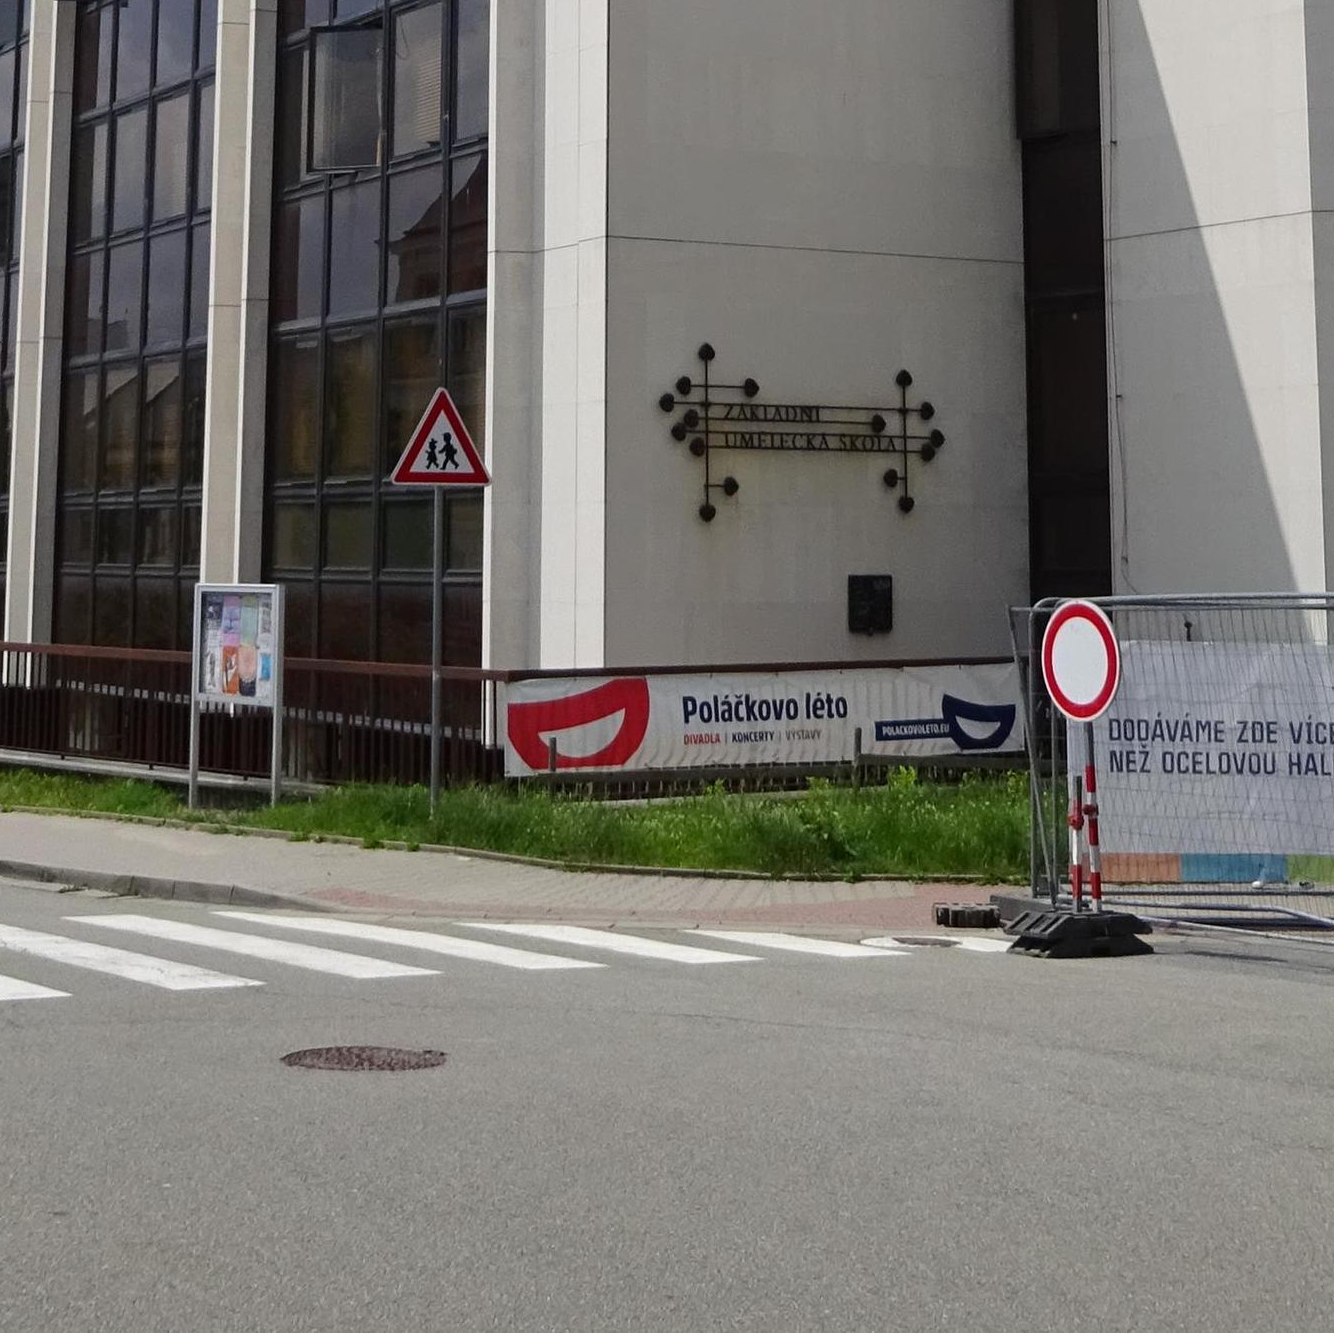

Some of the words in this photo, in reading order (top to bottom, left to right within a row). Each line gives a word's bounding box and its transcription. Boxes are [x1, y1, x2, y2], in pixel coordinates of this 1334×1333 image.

[682, 694, 799, 724] Poláčkovo
[805, 692, 848, 720] léto
[683, 732, 721, 745] DIVADLA
[731, 731, 775, 744] KONCERTY
[1108, 712, 1226, 743] DODÁVÁME
[1236, 720, 1279, 745] ZDE
[1109, 744, 1152, 774] NEŽ
[1161, 750, 1277, 776] OCELOVOU
